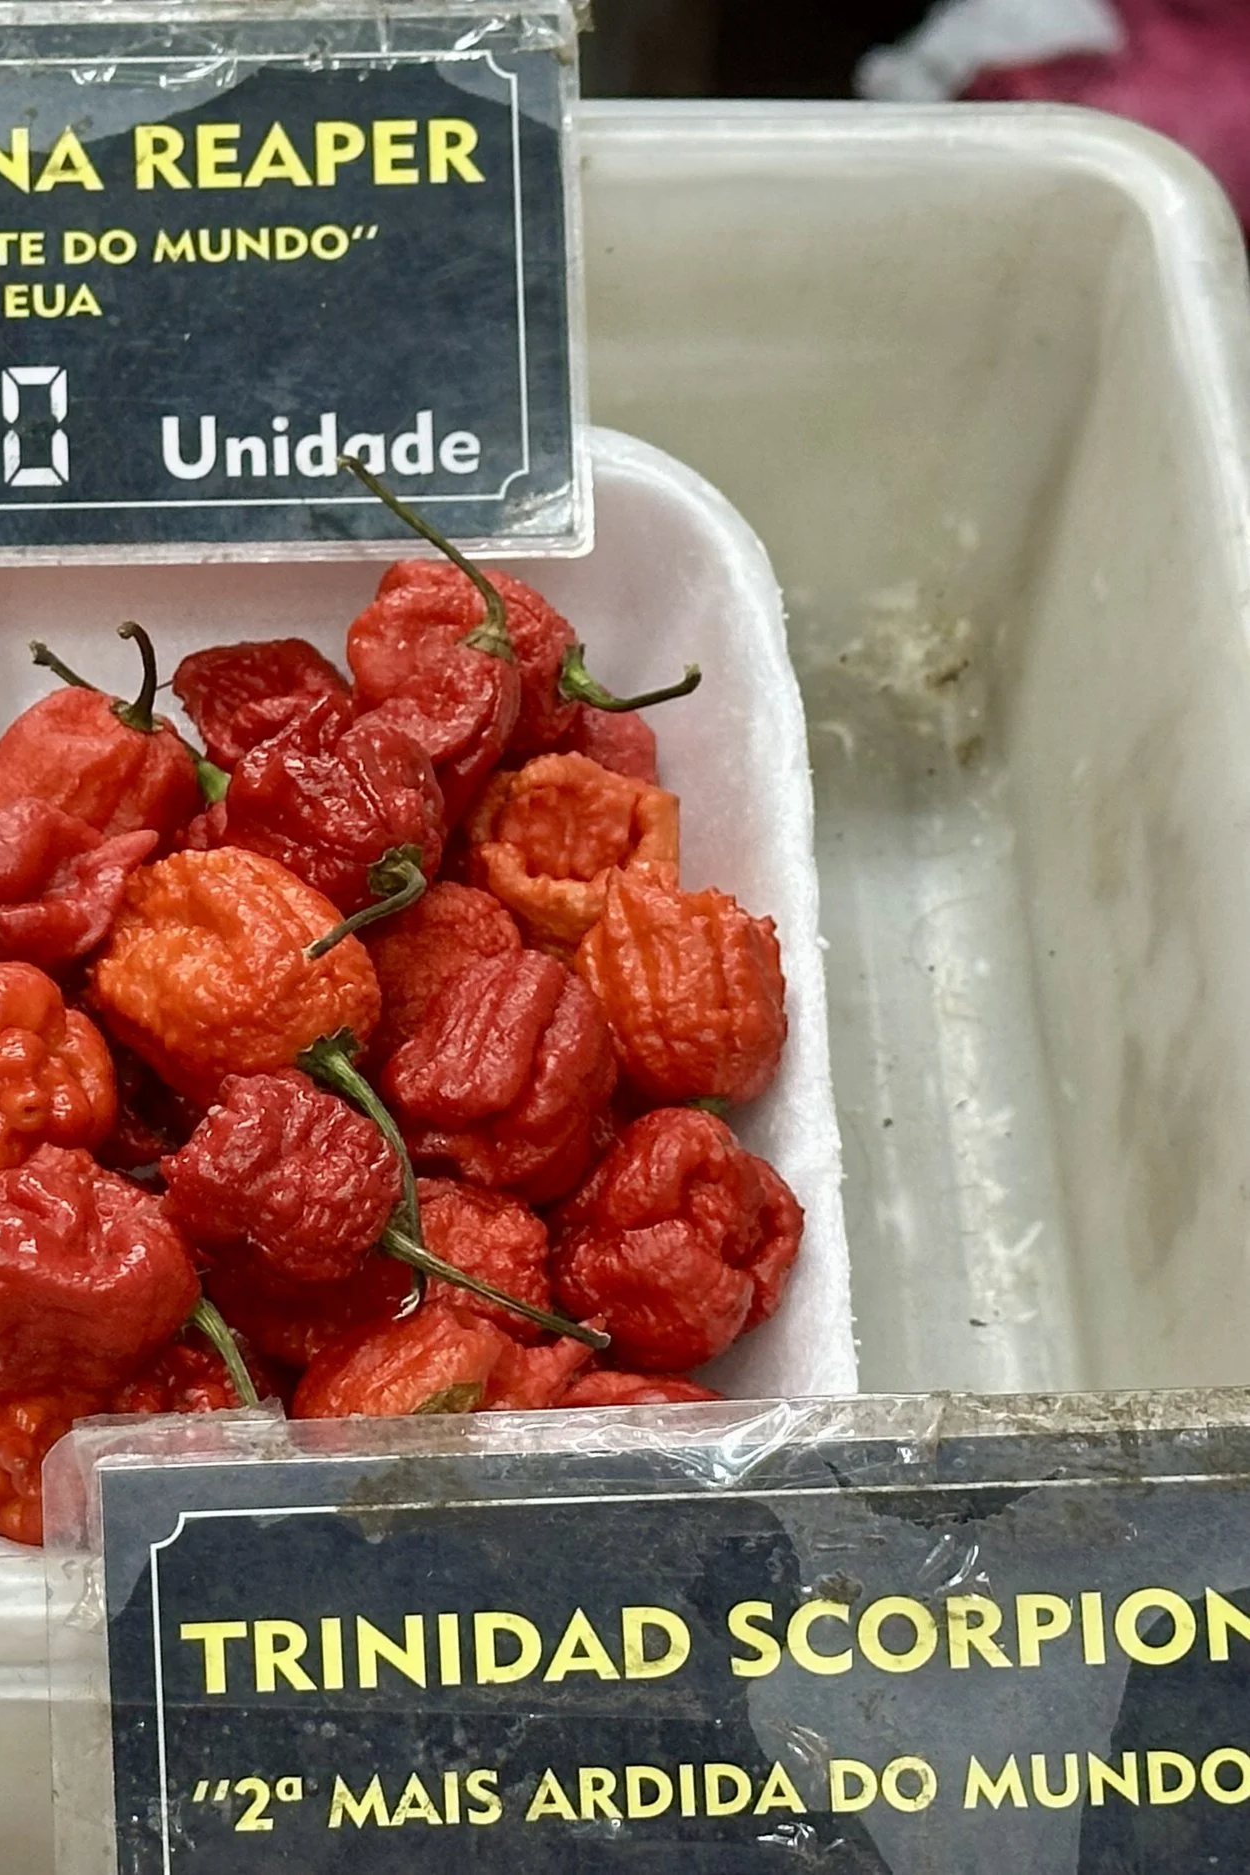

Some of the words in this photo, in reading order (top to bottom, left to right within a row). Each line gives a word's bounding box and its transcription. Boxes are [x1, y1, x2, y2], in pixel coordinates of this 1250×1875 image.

[134, 117, 485, 191] REAPER
[61, 231, 139, 267] DO
[2, 284, 103, 319] EUA
[160, 408, 482, 481] Unidade
[179, 1605, 691, 1694] TRINIDAD
[728, 1586, 1250, 1678] SCORPION
[328, 1767, 504, 1827] MAIS
[523, 1758, 804, 1823] ARDIDA
[830, 1755, 938, 1814] DO
[961, 1747, 1250, 1810] MUNDO
